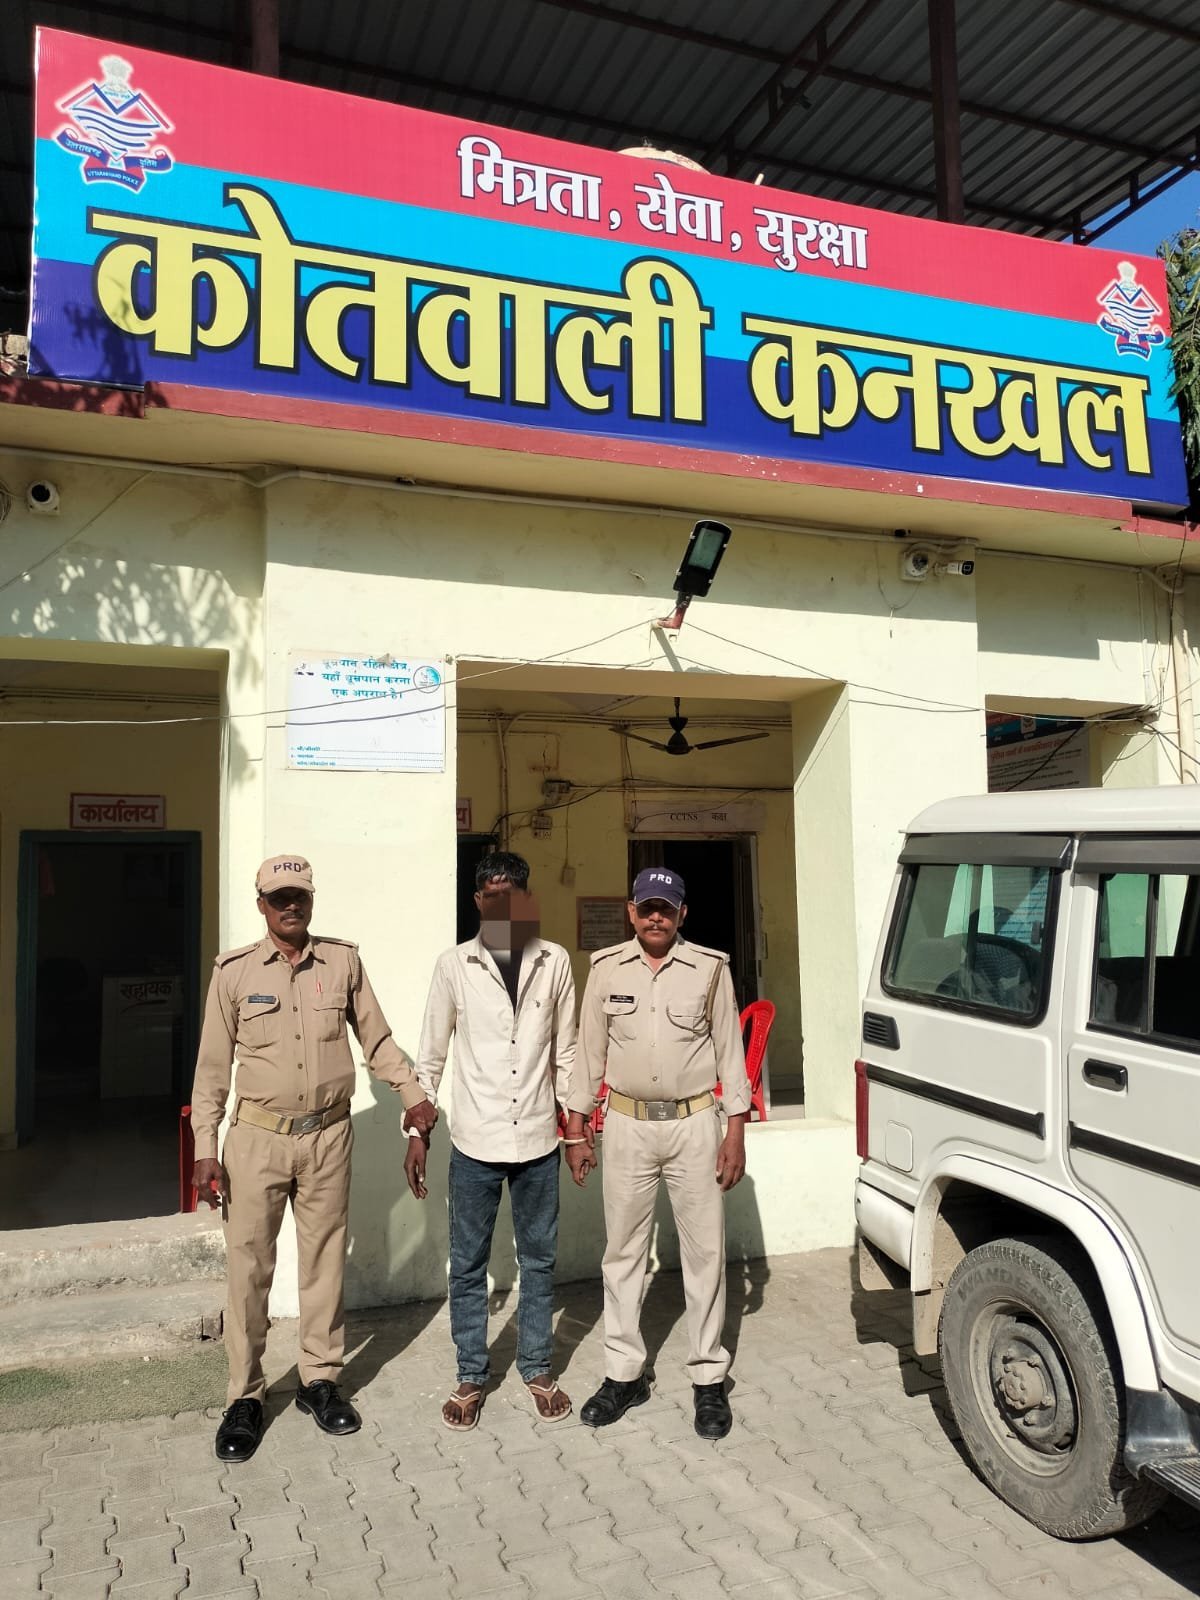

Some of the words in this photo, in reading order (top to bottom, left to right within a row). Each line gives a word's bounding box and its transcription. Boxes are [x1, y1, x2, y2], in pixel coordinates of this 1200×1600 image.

[753, 207, 868, 272] सुरक्षा
[87, 183, 714, 422] कोतवाली
[742, 313, 1154, 476] कनखल
[321, 671, 340, 681] यहाँ
[384, 677, 410, 685] करना
[331, 689, 348, 697] एक
[78, 799, 159, 823] कार्यालय
[669, 812, 699, 821] CCTNS
[273, 861, 302, 873] PRD
[649, 873, 672, 884] PRD
